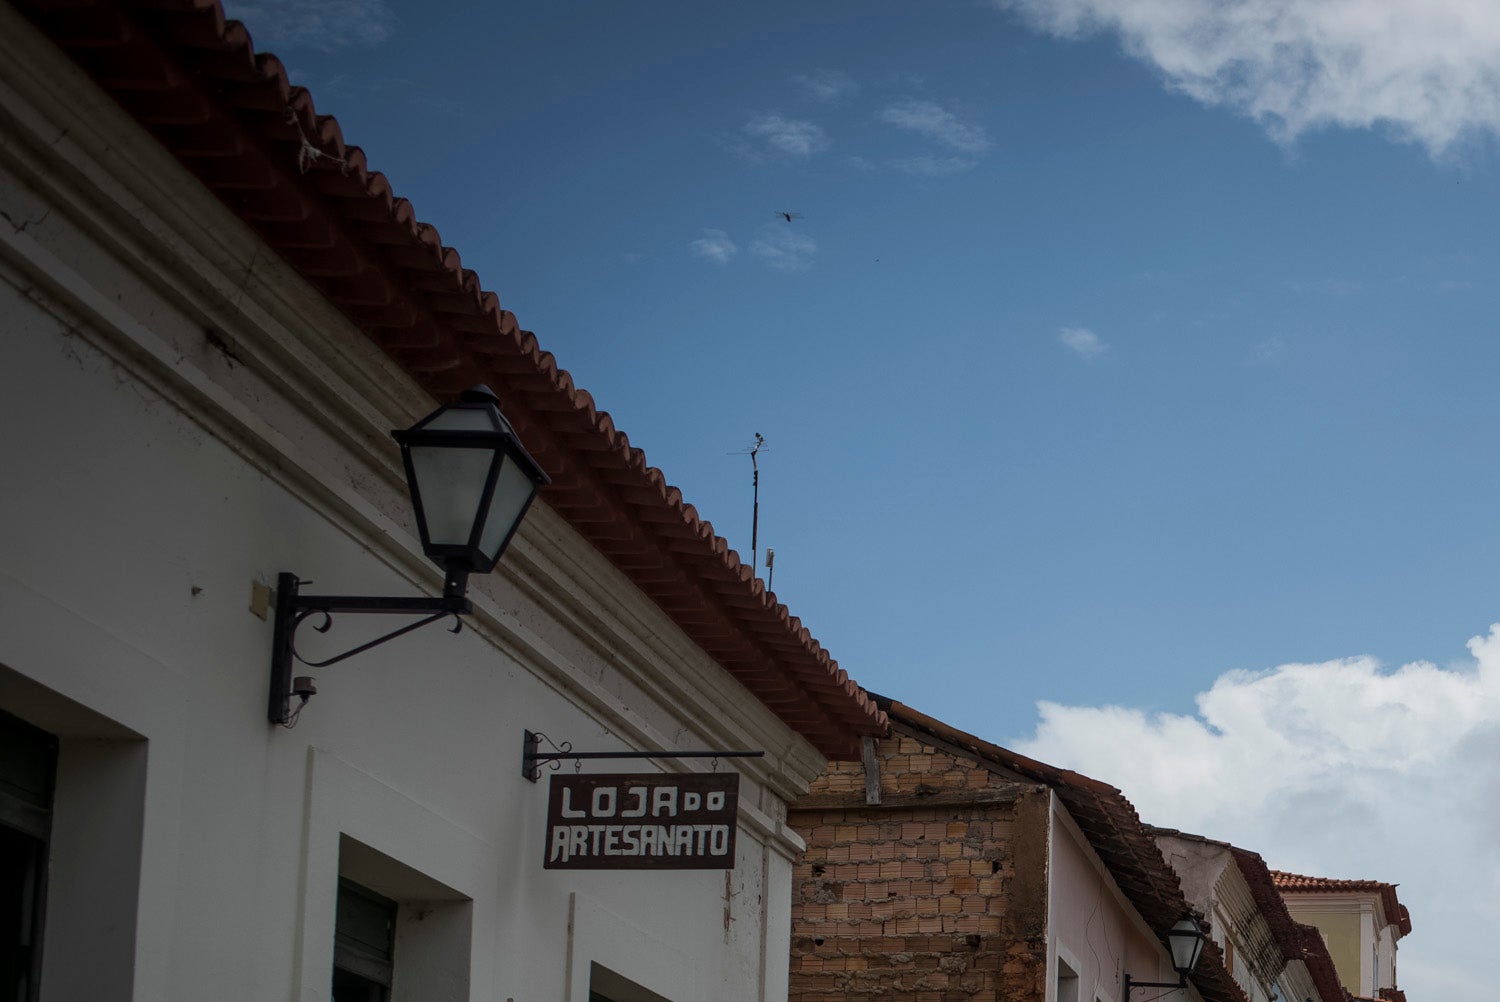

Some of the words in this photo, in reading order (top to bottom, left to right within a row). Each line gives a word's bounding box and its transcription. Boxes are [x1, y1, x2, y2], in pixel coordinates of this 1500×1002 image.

[561, 786, 679, 818] LOJA
[684, 791, 726, 811] DO
[550, 824, 730, 863] ARTESANATO
